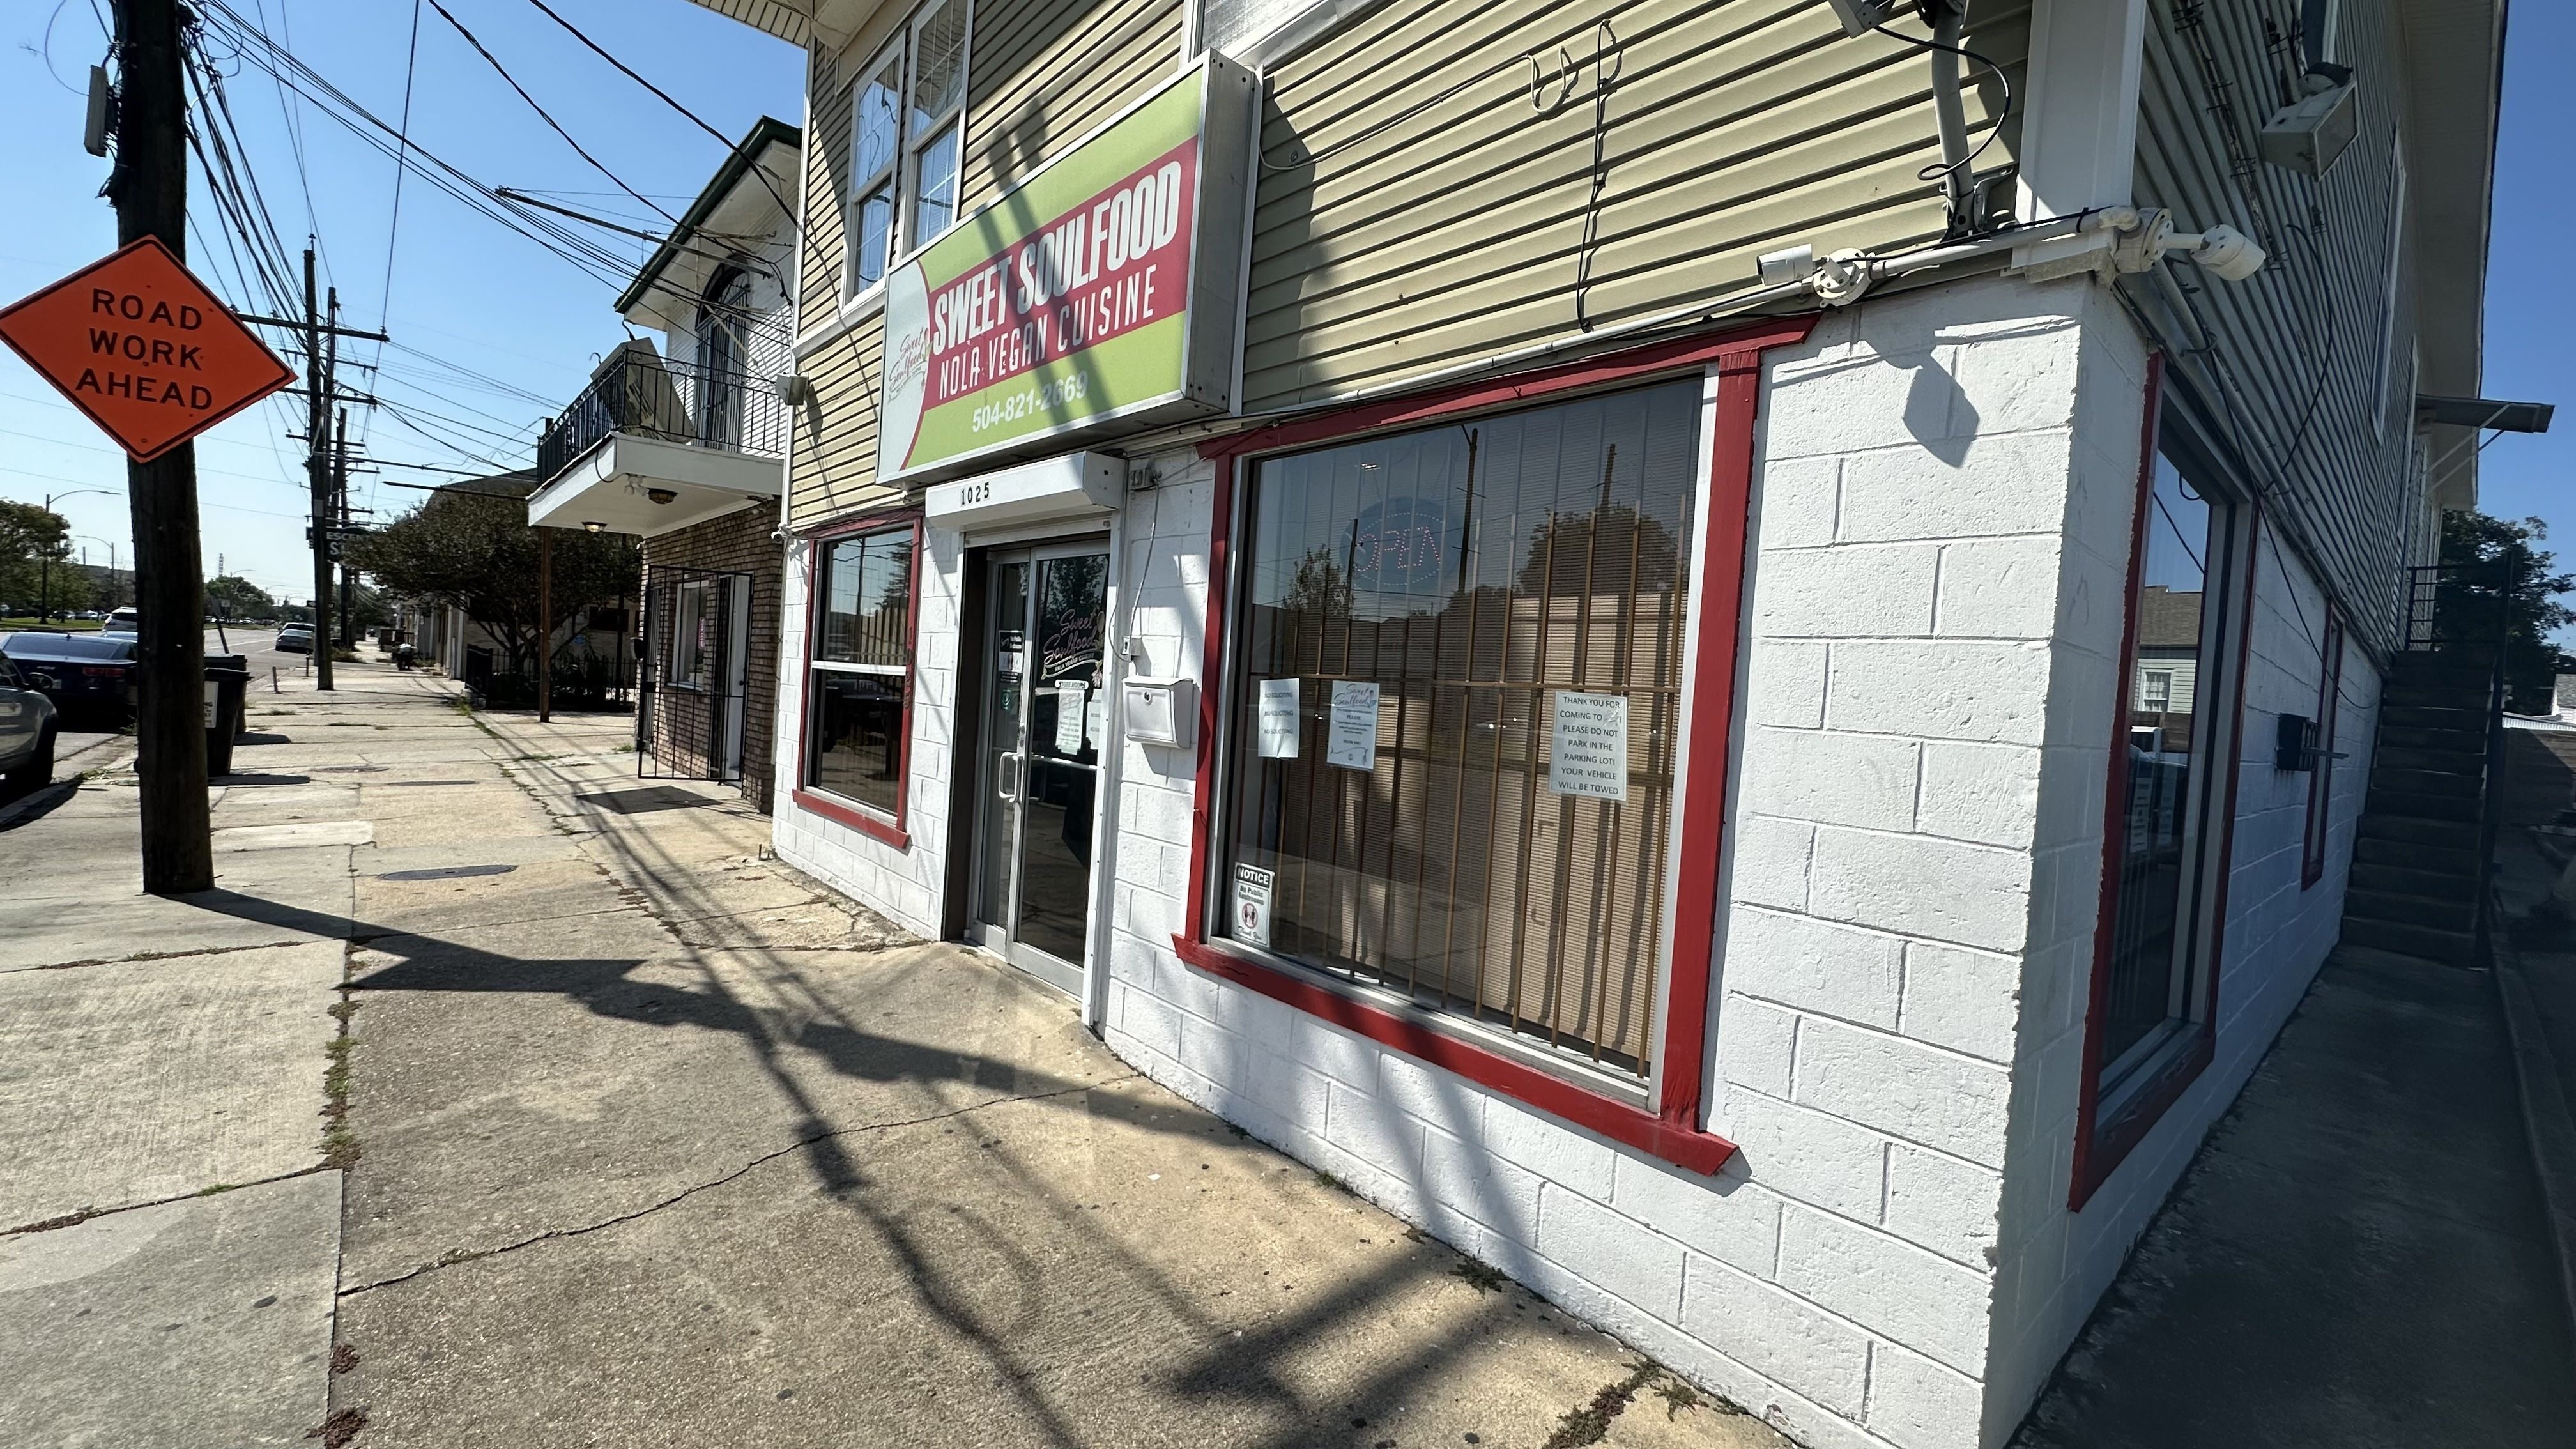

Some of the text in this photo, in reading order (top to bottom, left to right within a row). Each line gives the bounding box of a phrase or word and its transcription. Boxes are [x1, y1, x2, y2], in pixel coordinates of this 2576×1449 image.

[933, 161, 1181, 355] SWEET SOULFOOD
[92, 288, 202, 330] ROAD
[939, 346, 981, 400] NOLA
[988, 314, 1048, 380] VEGAN
[1057, 264, 1156, 352] CUISINE
[89, 328, 202, 371] WORK
[75, 368, 213, 410] AHEAD
[972, 371, 1088, 433] 504-821-2669
[962, 482, 990, 505] 1025
[1353, 526, 1441, 572] OPEN
[1060, 607, 1097, 636] Sweet
[1043, 626, 1098, 664] Soulfood
[1564, 696, 1588, 705] THANK
[1560, 710, 1591, 720] COMING
[1563, 725, 1618, 737] PLEASE DO NOT
[1564, 753, 1597, 763] PARKING
[1568, 739, 1588, 748] PARK
[1599, 742, 1613, 751] THE
[1561, 767, 1616, 780] YOUR VEHICLE
[1558, 781, 1618, 795] WILL BE TOWED
[1238, 867, 1269, 885] NOTICE
